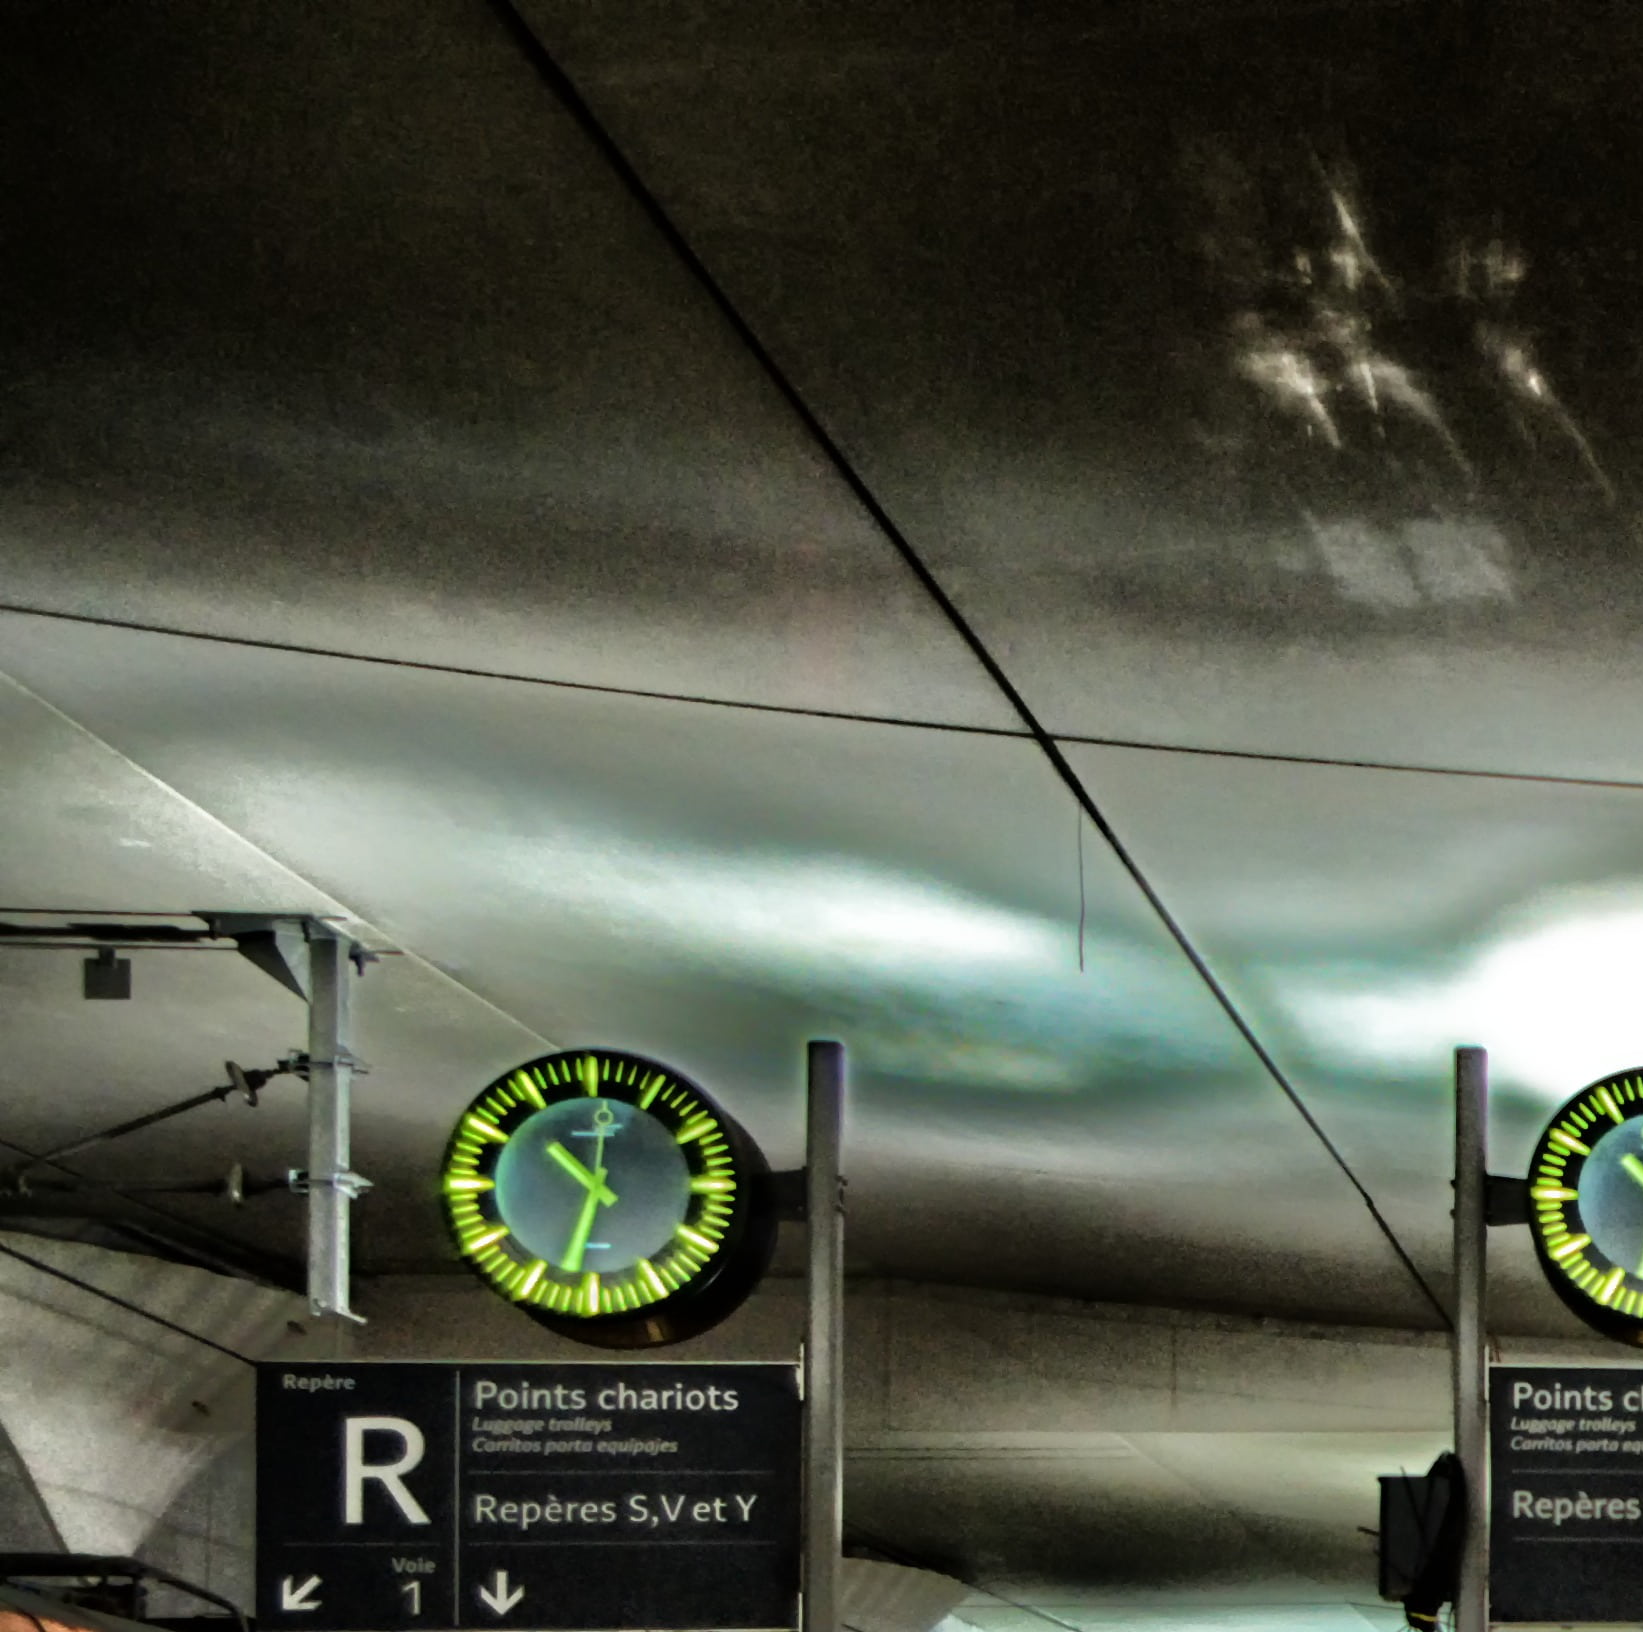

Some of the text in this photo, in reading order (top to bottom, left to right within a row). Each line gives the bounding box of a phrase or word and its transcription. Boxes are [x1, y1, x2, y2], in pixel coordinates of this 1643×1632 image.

[282, 1373, 357, 1392] Repère
[475, 1380, 740, 1411] Points chariots
[1513, 1382, 1613, 1411] Points
[472, 1416, 613, 1435] Luggage trolleys
[1511, 1416, 1636, 1434] Luggage trolleys
[472, 1437, 679, 1456] Carritos porta equipajes
[1511, 1436, 1573, 1452] Carritos
[1575, 1438, 1620, 1454] porta
[345, 1416, 431, 1525] R
[474, 1494, 618, 1531] Repères
[691, 1497, 728, 1523] et
[735, 1494, 758, 1522] Y
[1513, 1490, 1642, 1526] Repères
[391, 1557, 436, 1574] Voie
[402, 1581, 421, 1615] 1
